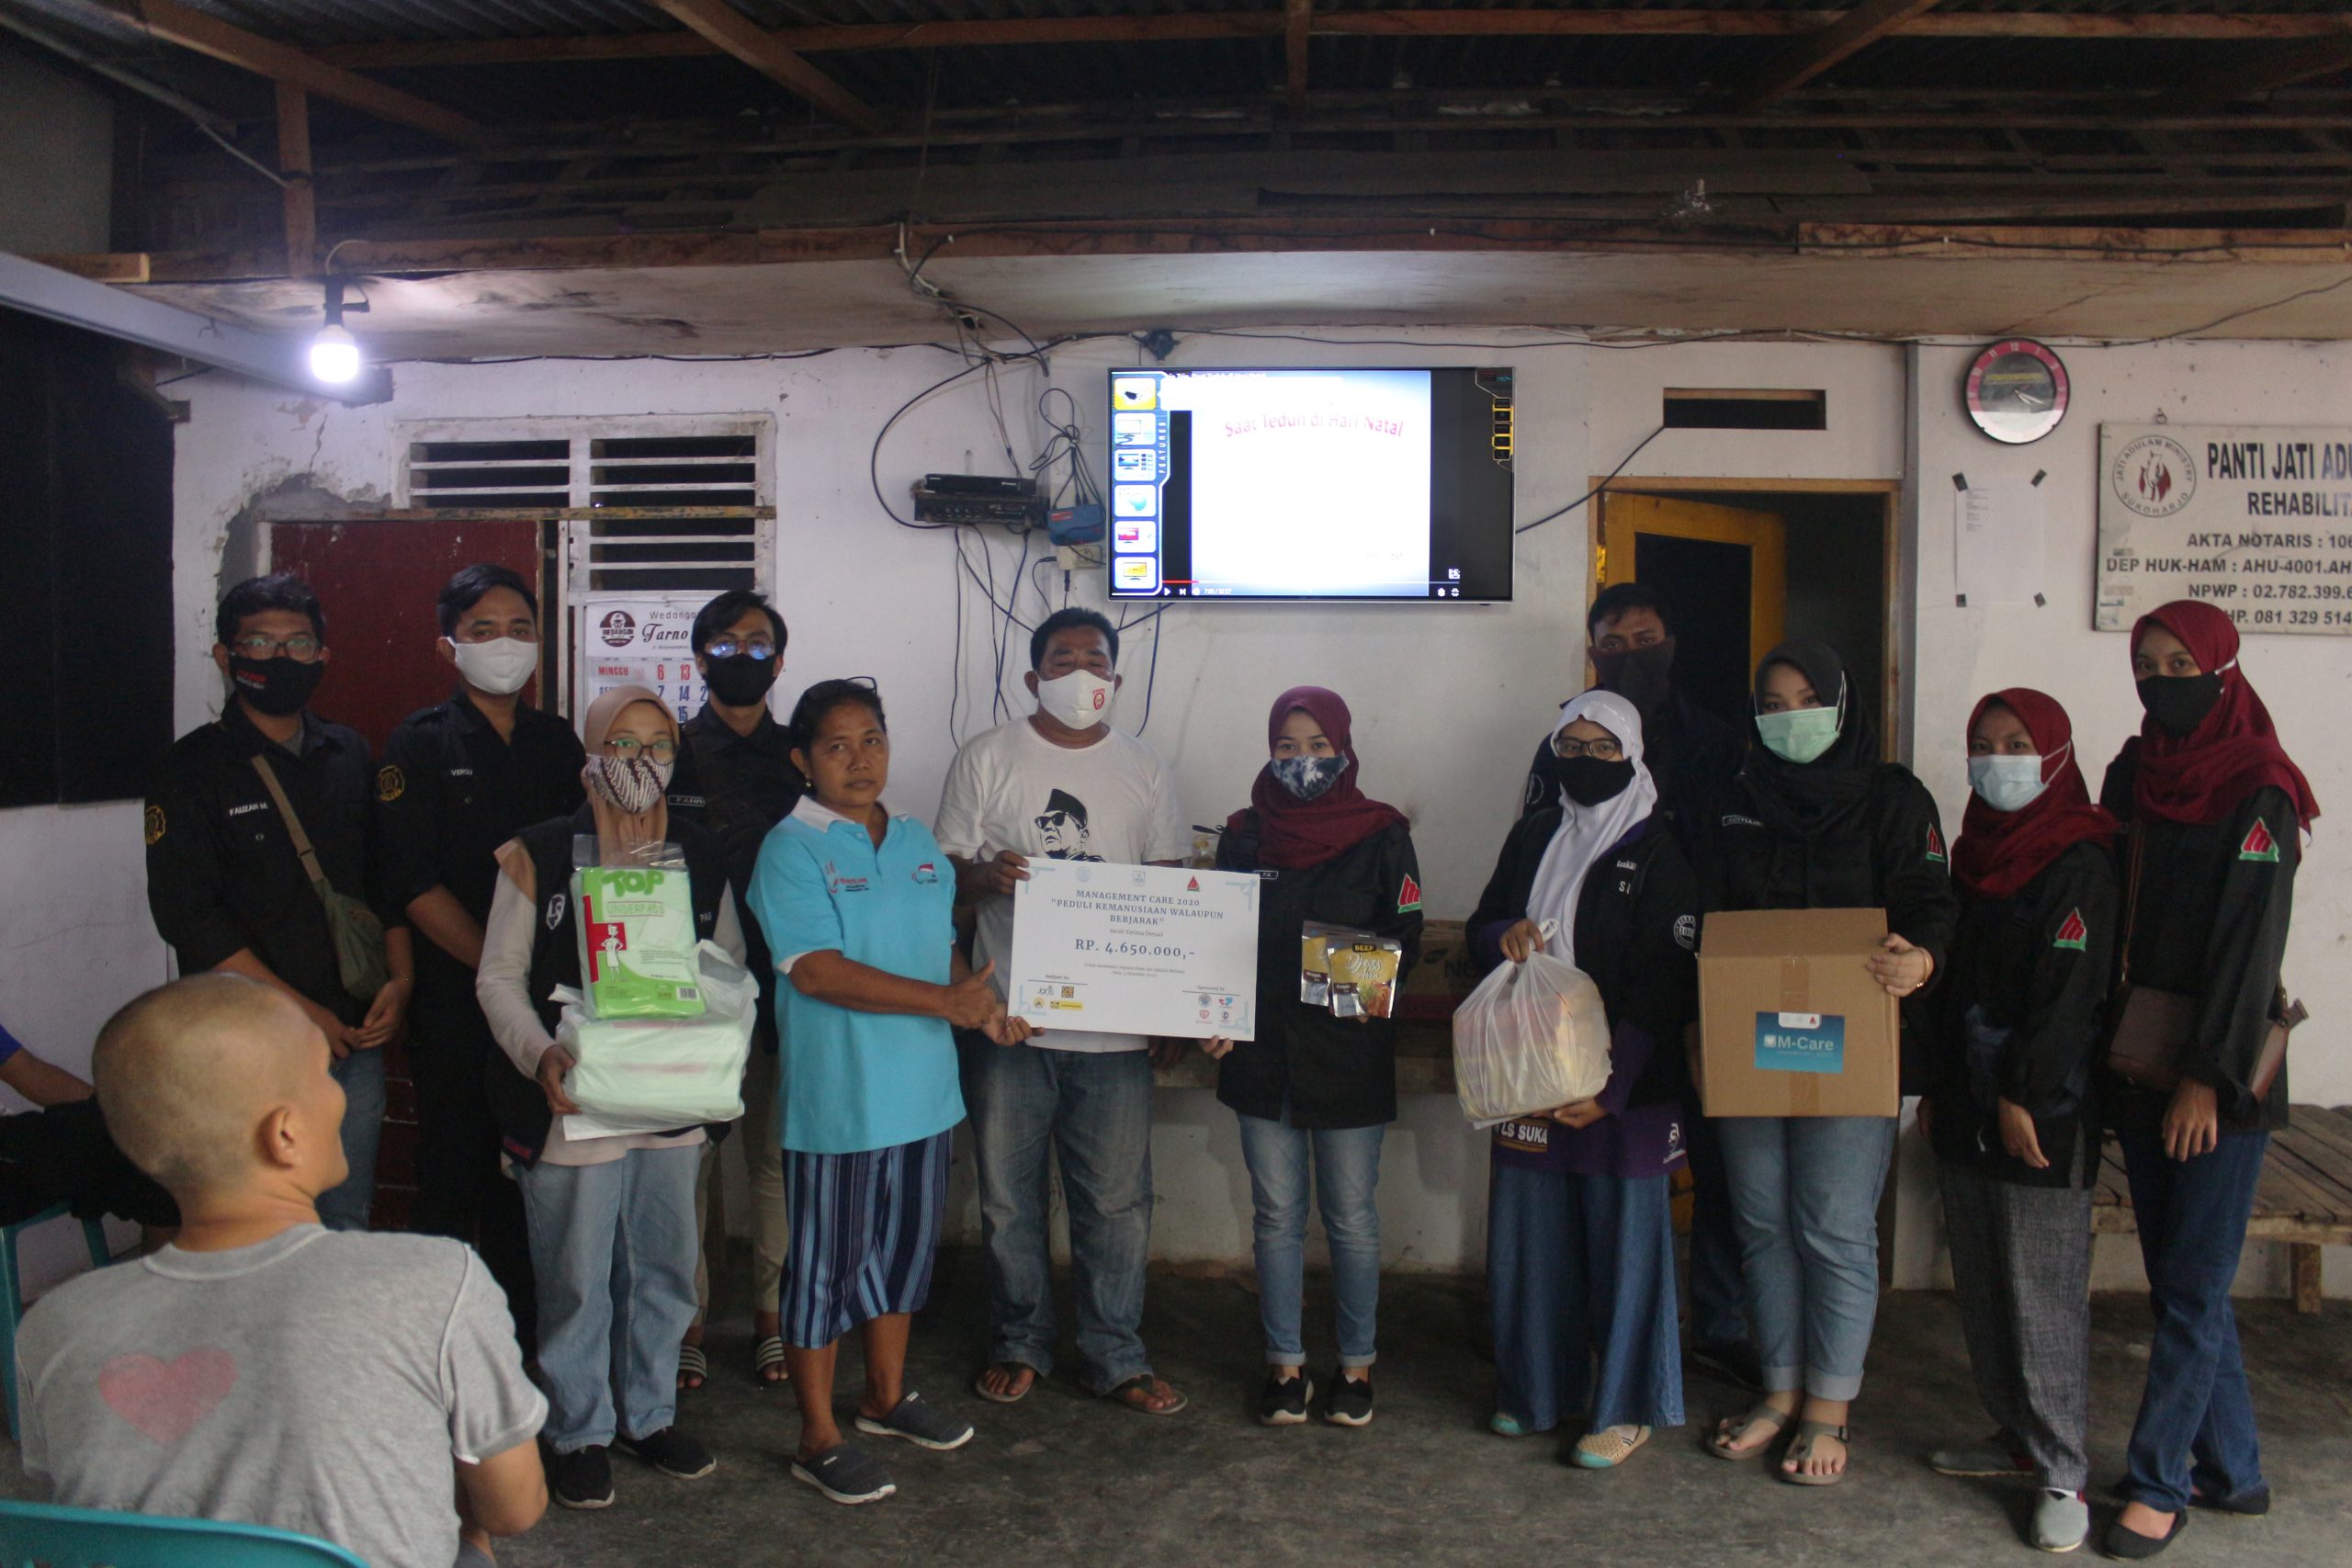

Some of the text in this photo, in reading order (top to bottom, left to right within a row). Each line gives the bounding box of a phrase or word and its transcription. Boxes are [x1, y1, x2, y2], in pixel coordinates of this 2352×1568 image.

[1363, 414, 1404, 437] Natal
[2208, 442, 2265, 479] PANTI
[2272, 443, 2314, 480] JATI
[2247, 491, 2352, 517] REHABILIT
[2187, 533, 2233, 547] AKTA
[2238, 533, 2312, 548] NOTARIS
[2106, 558, 2140, 572] DEP
[2145, 558, 2226, 573] HUK-HAM
[2188, 583, 2238, 598] NPWP
[2254, 609, 2282, 624] 081
[2289, 610, 2318, 625] 329
[598, 665, 629, 677] MINGGU
[657, 664, 665, 681] 6
[680, 664, 691, 681] 13
[657, 685, 665, 698] 7
[679, 685, 691, 702] 14
[678, 705, 688, 722] 15
[601, 870, 665, 897] TOP
[1076, 890, 1200, 907] MANAGEMENT CARE 2020
[1095, 902, 1167, 916] KEMANUSIAAN
[1170, 908, 1224, 919] WALAUPUN
[1075, 938, 1099, 952] RP.
[1777, 1035, 1834, 1051] M-Care
[1518, 1124, 1548, 1145] SUKA
